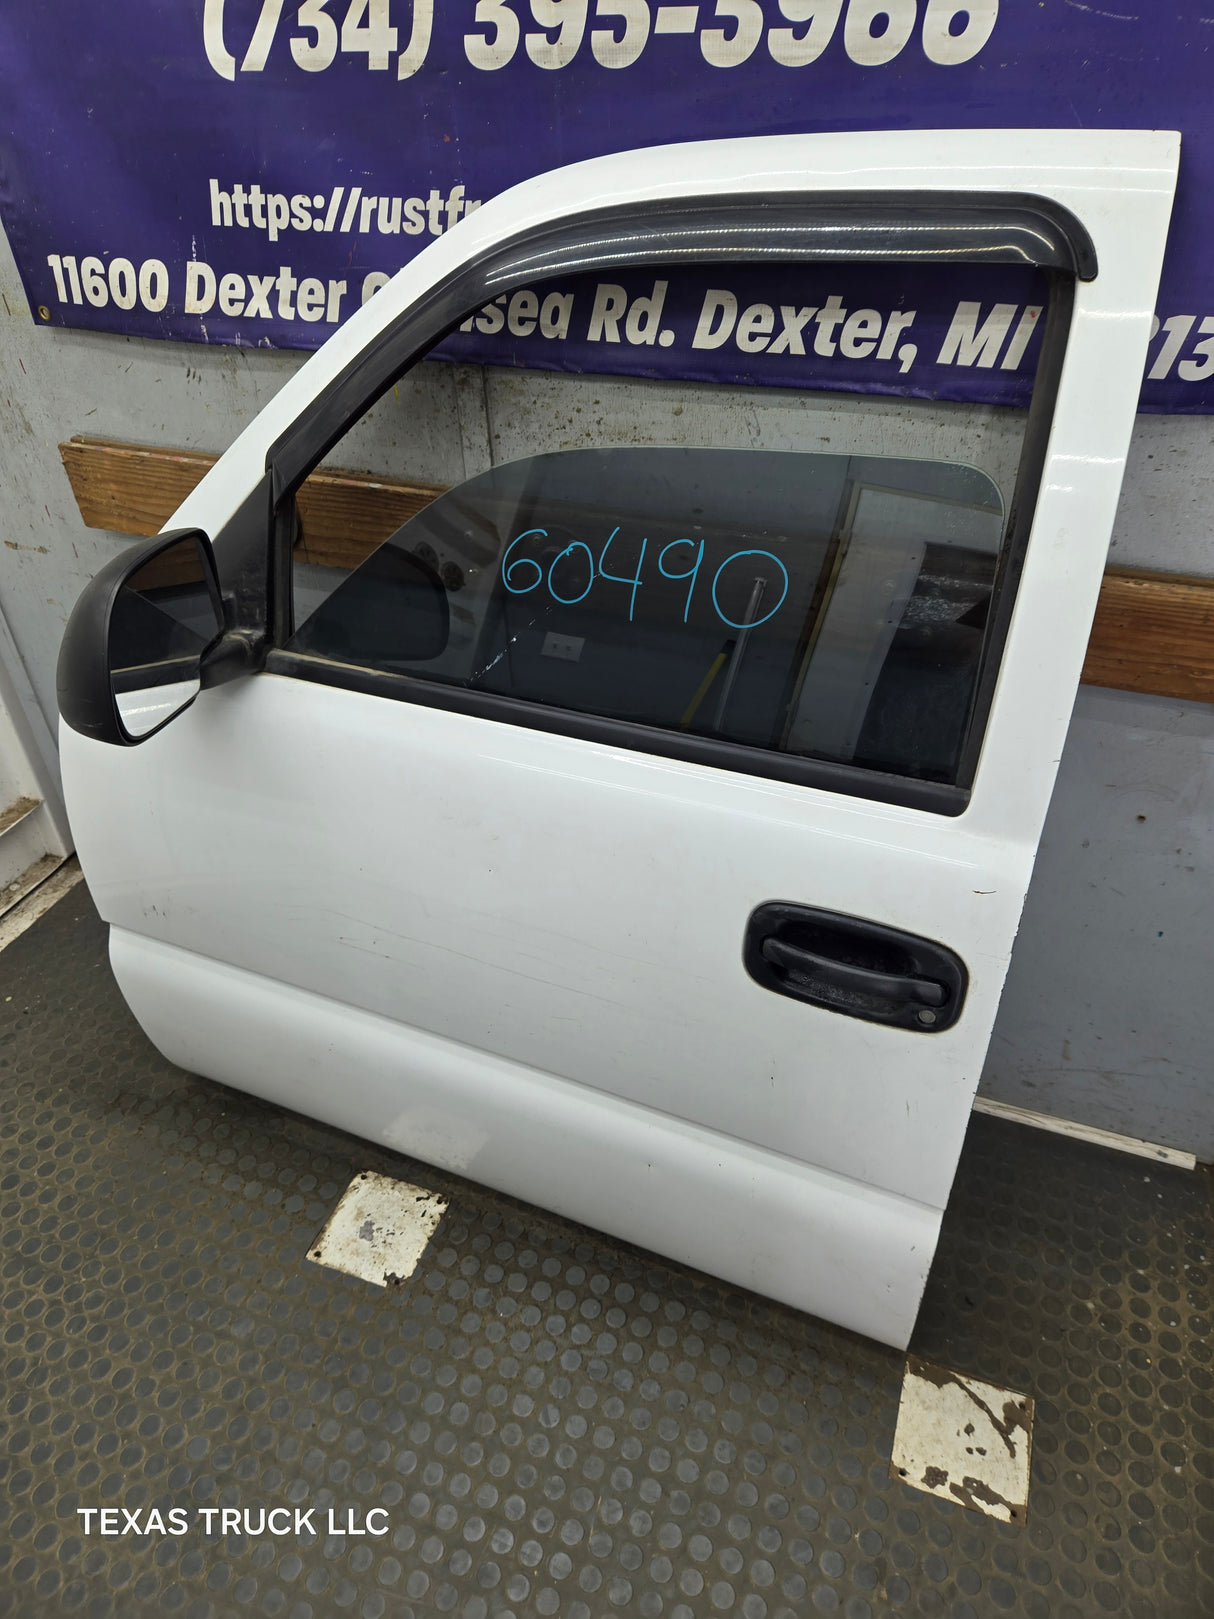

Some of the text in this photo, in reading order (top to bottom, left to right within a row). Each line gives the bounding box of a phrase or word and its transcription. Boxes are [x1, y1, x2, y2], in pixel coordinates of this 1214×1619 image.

[48, 254, 169, 312] 11600
[185, 261, 346, 323] Dexter
[587, 280, 675, 348] Rd.
[692, 289, 917, 373] Dexter,
[936, 301, 1043, 371] MI
[502, 527, 789, 628] 60490
